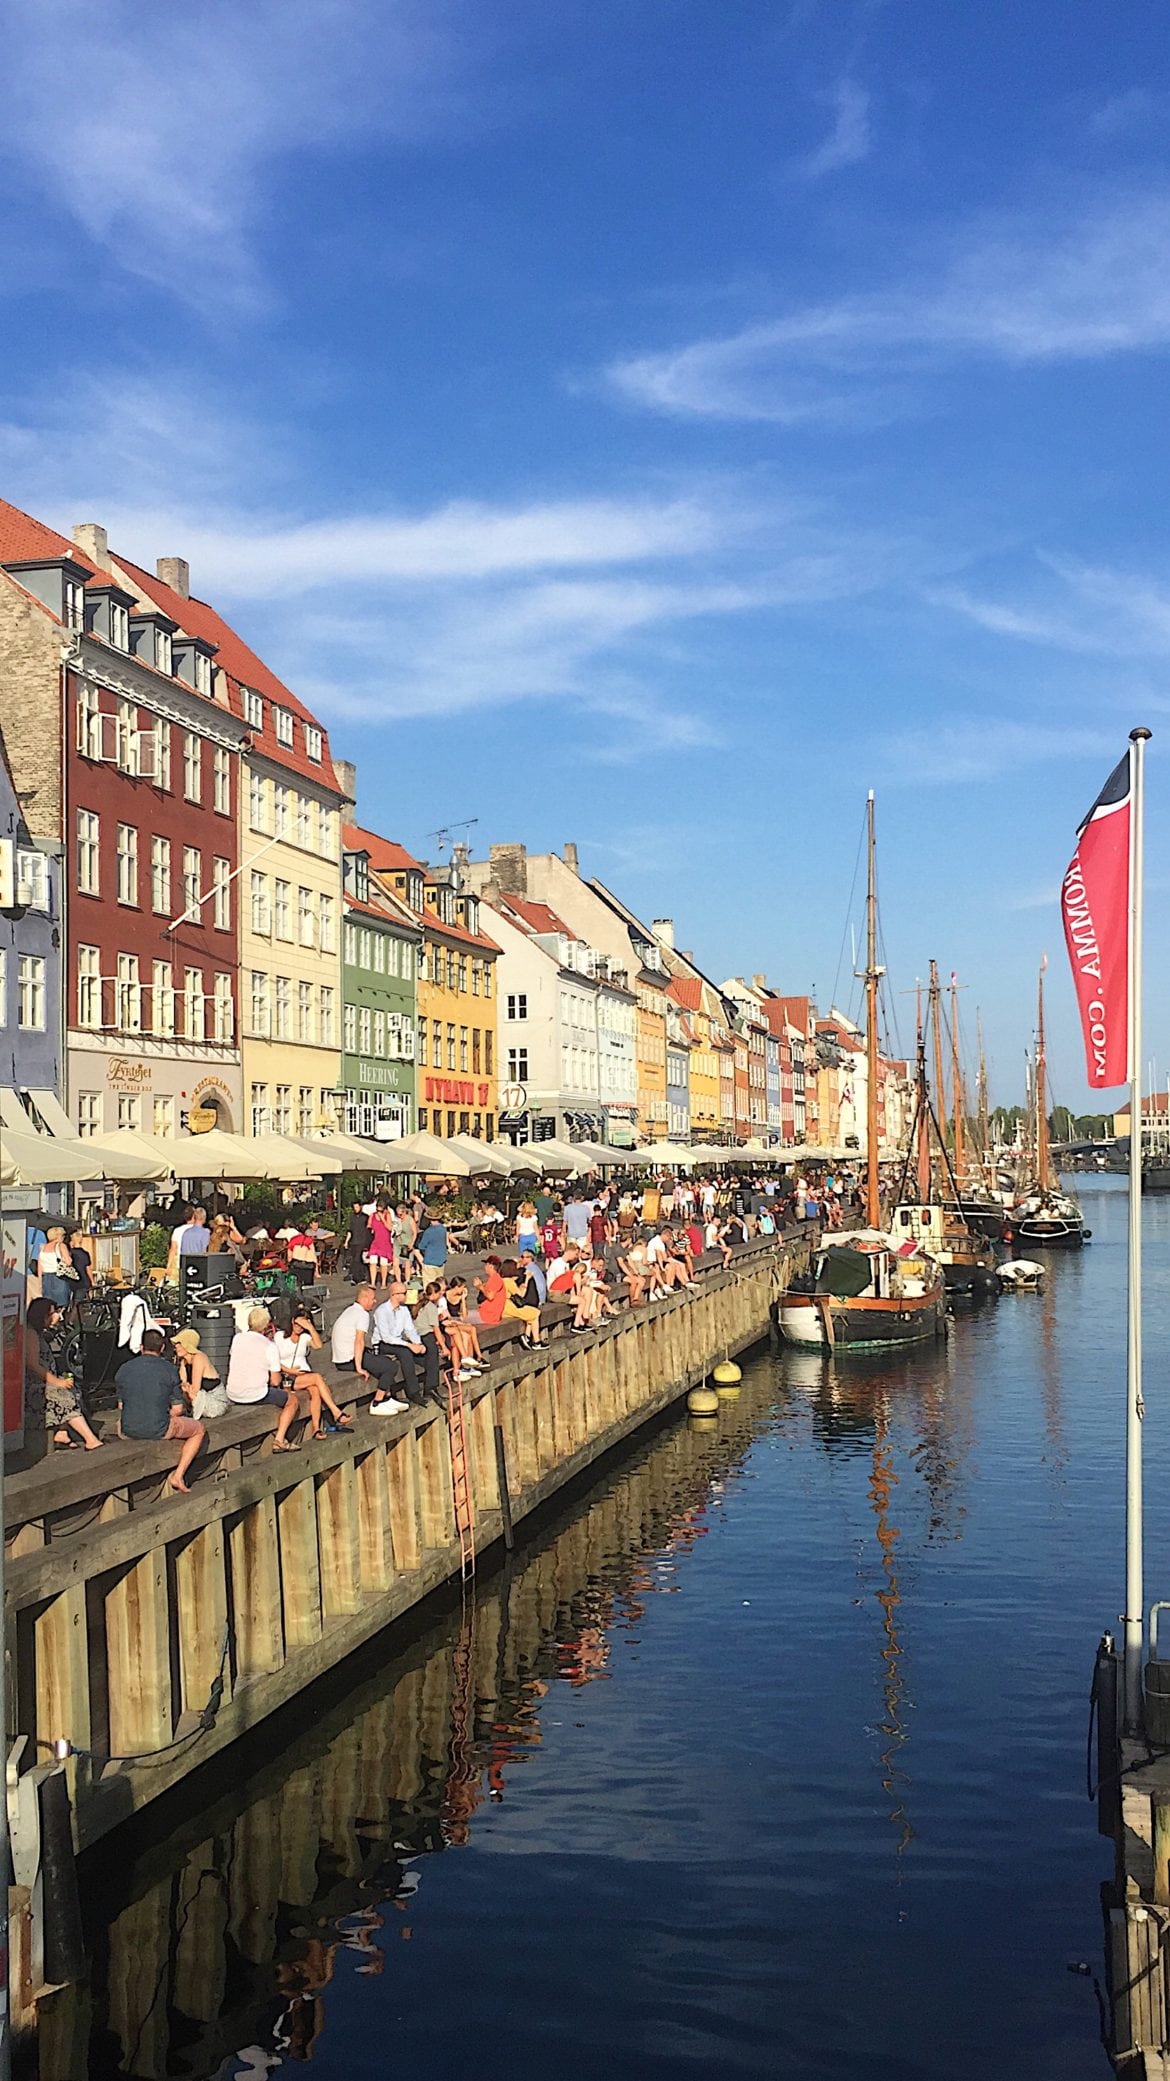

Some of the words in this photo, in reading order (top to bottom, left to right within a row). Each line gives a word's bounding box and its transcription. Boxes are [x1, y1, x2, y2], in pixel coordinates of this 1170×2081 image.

[359, 1062, 399, 1087] HEERING
[425, 1076, 474, 1105] NYHAVN
[502, 1087, 520, 1107] 17
